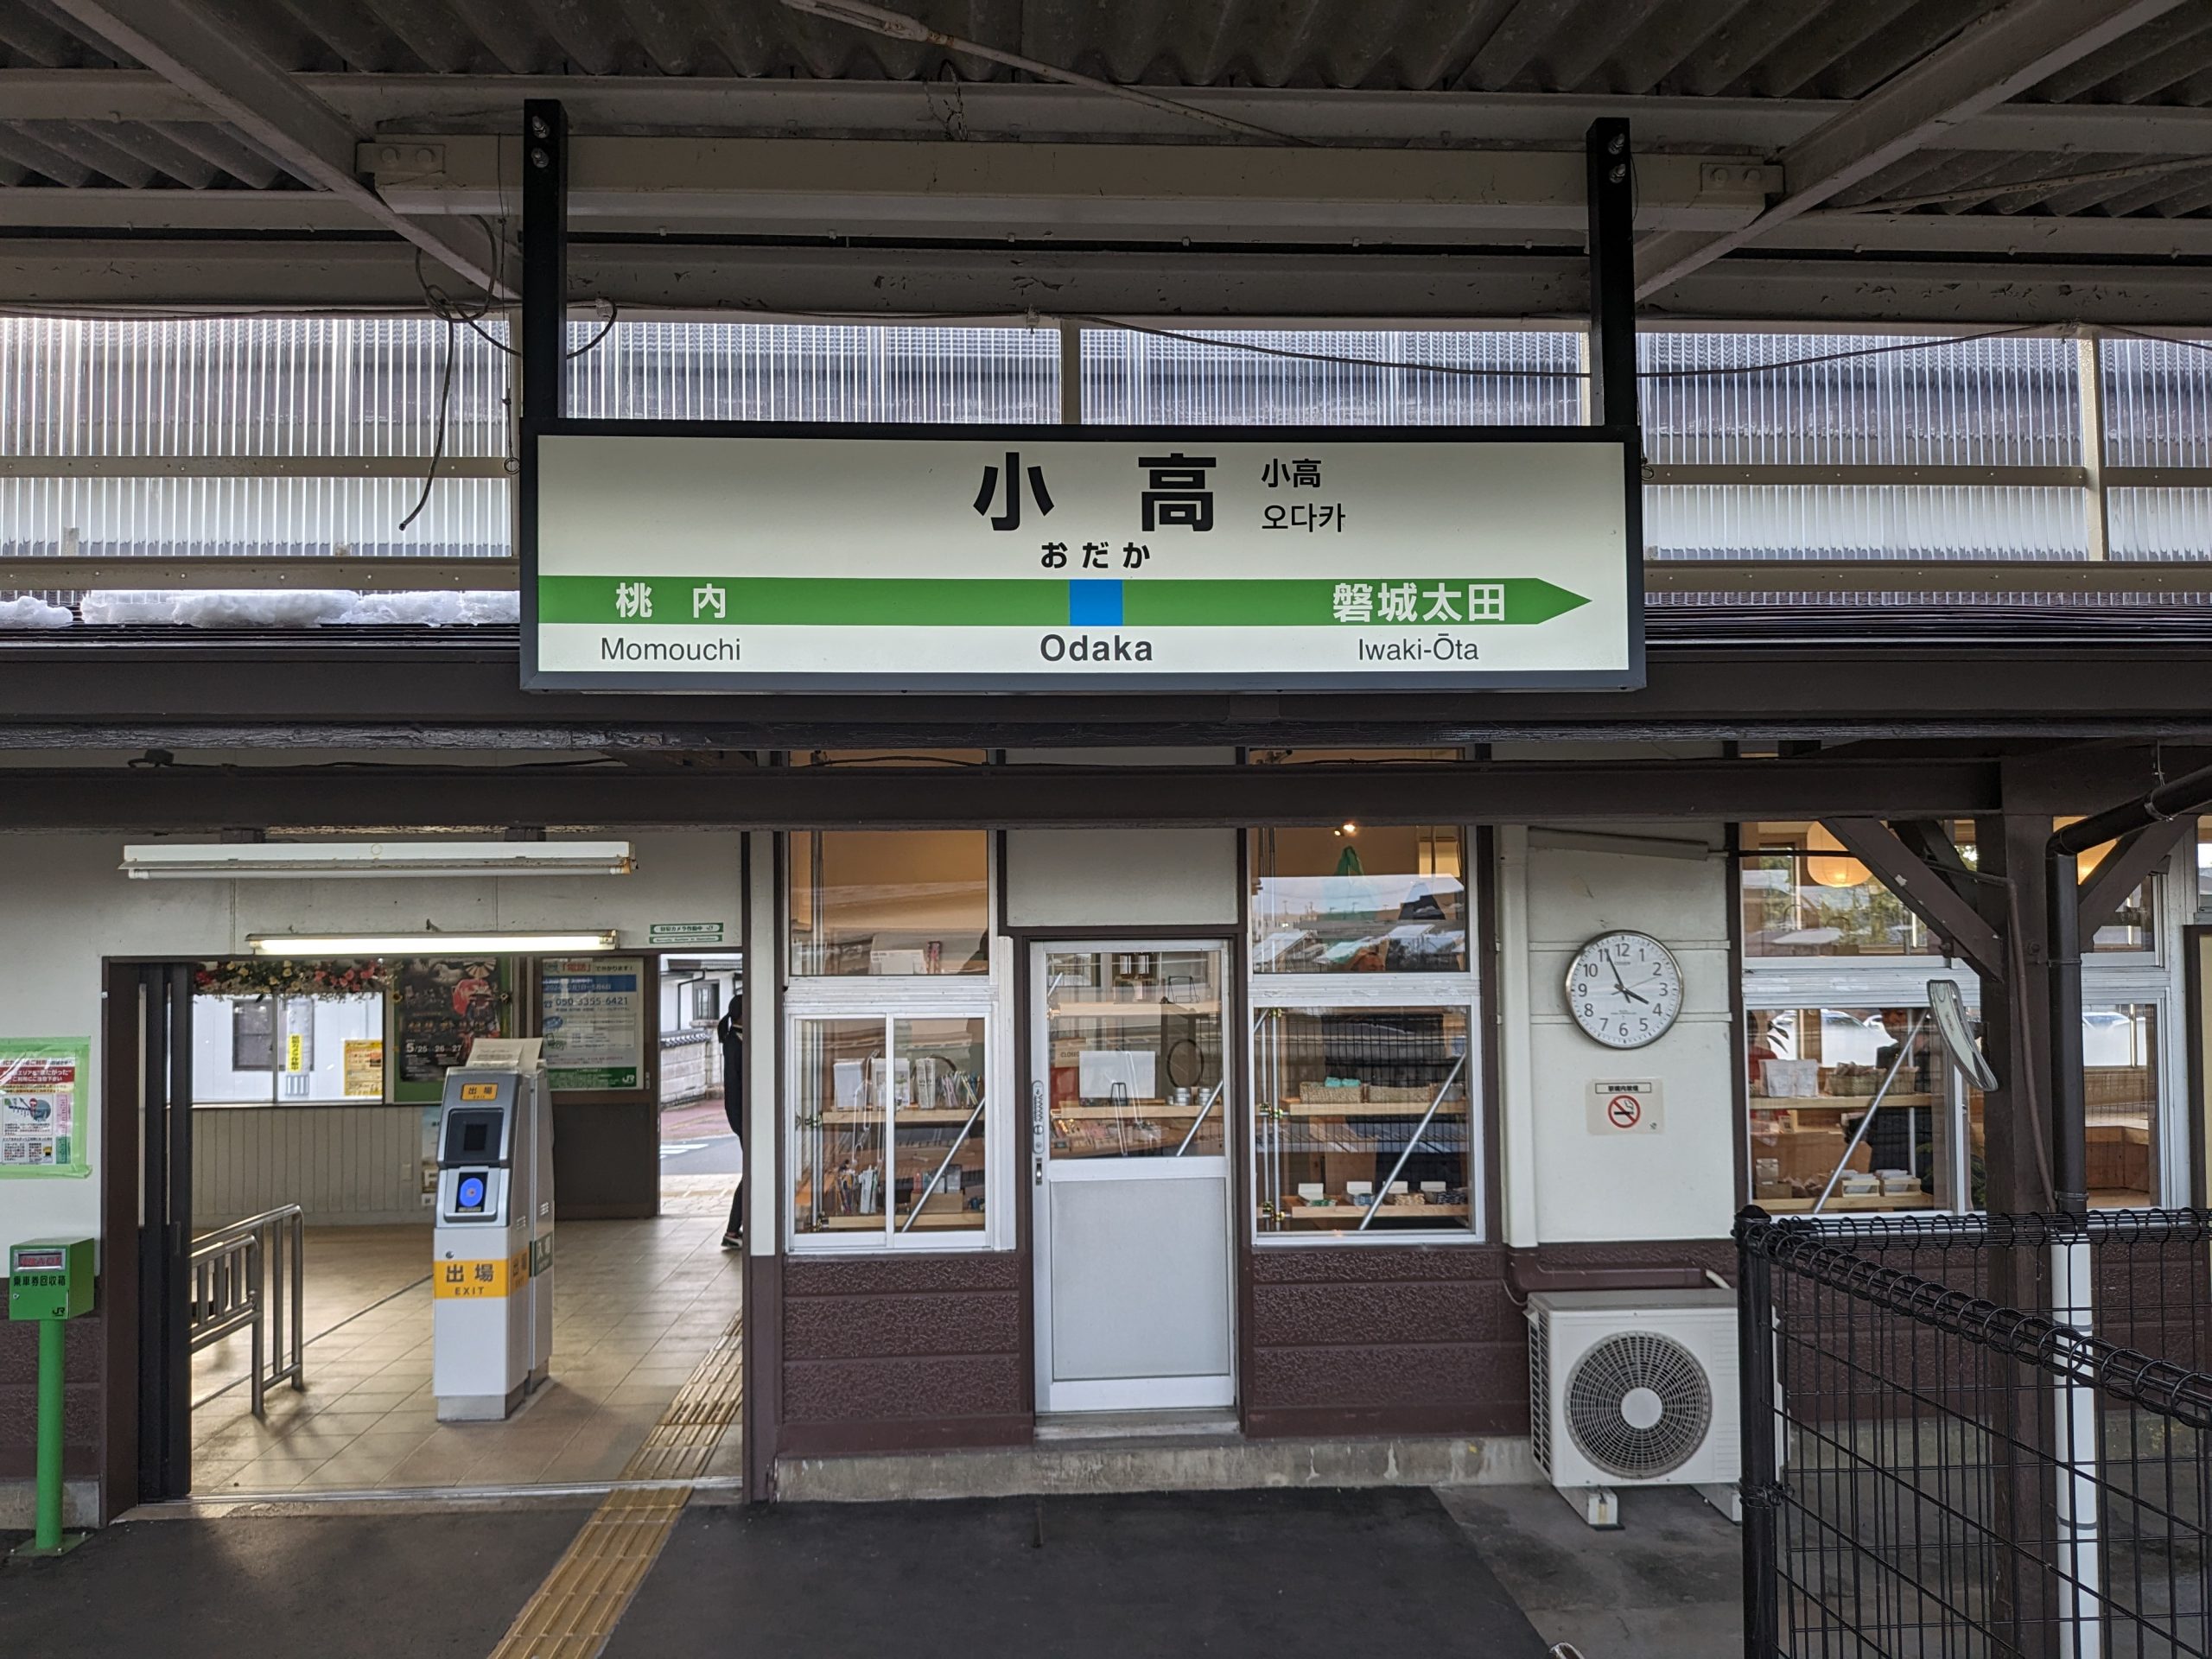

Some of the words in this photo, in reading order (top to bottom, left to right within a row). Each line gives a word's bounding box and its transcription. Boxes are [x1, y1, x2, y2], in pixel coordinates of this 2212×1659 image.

[1261, 458, 1322, 488] 小高
[973, 451, 1217, 532] 小高
[1262, 503, 1346, 533] 오다카
[1040, 541, 1150, 569] おだか
[615, 582, 727, 619] 桃内
[1332, 582, 1505, 623] 磐城太田
[601, 637, 741, 661] Momouchi
[1040, 633, 1153, 662] Odaka
[1359, 632, 1479, 661] Iwaki-Ōta
[1615, 943, 1630, 957] 12
[1638, 948, 1645, 962] 1
[1583, 963, 1599, 977] 10
[1652, 962, 1662, 976] 2
[1578, 983, 1588, 997] 9
[1658, 982, 1669, 996] 3
[1584, 1003, 1594, 1017] 8
[1652, 1002, 1662, 1017] 4
[1599, 1017, 1609, 1032] 7
[1618, 1022, 1629, 1037] 6
[1639, 1018, 1649, 1032] 5
[13, 1274, 66, 1287] 乗車券回収箱
[446, 1263, 494, 1283] 出場
[454, 1287, 485, 1296] EXIT
[52, 1306, 66, 1317] JR
